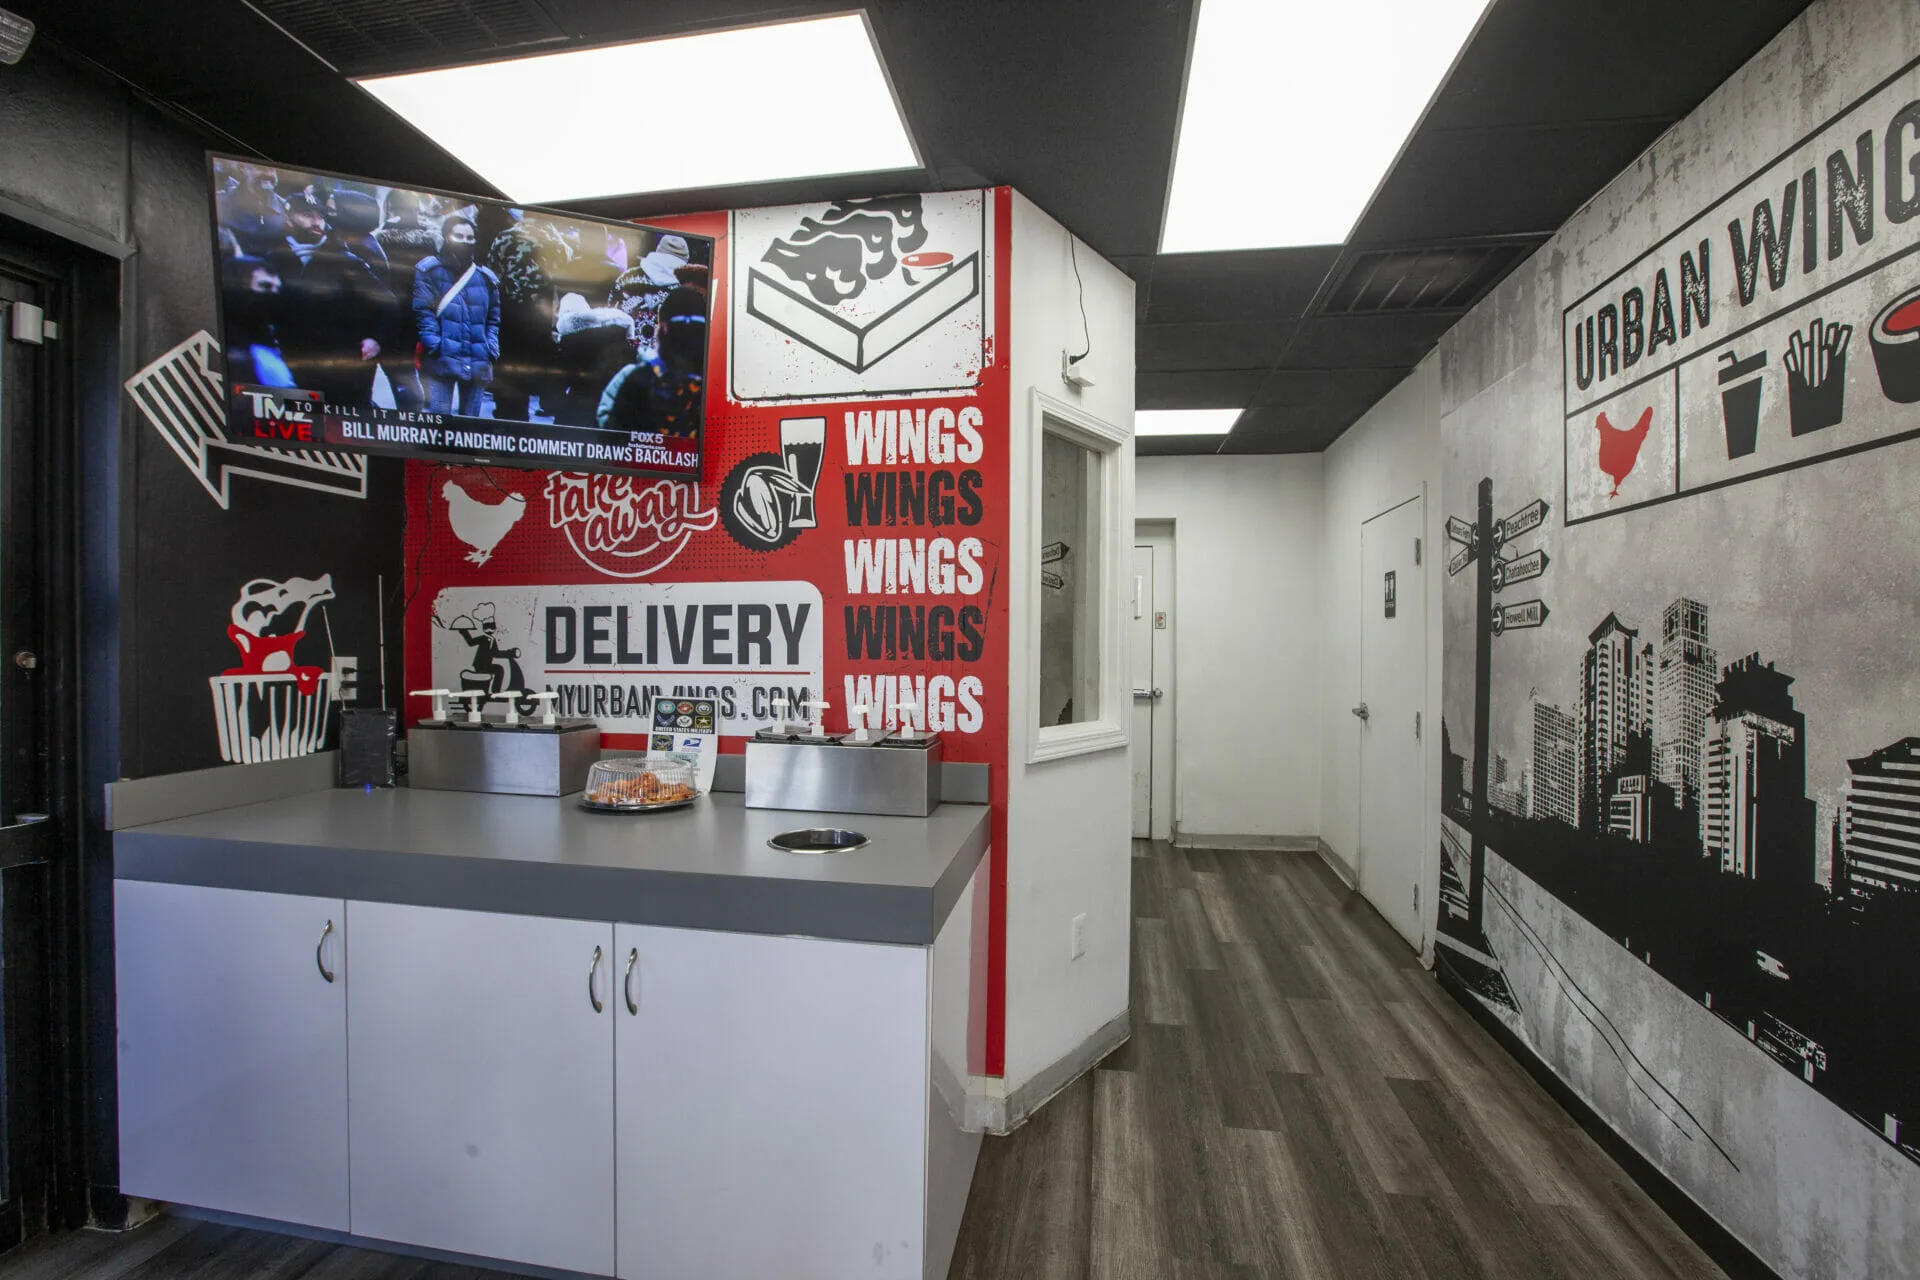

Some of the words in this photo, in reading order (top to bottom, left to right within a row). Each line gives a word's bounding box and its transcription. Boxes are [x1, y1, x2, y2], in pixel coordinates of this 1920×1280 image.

[1575, 237, 1710, 391] URBAN
[294, 400, 313, 412] TO
[323, 403, 360, 417] KILL
[372, 406, 387, 418] IT
[399, 411, 443, 425] MEANS
[630, 431, 654, 444] FOX
[654, 433, 665, 445] 5
[844, 406, 983, 465] WINGS
[342, 420, 375, 440] BILL
[377, 423, 442, 446] MURRAY:
[445, 431, 516, 451] PANDEMIC
[518, 437, 585, 457] COMMENT
[586, 443, 633, 462] DRAWS
[635, 448, 699, 468] BACKLASH
[543, 471, 633, 529] take
[585, 479, 718, 551] away
[844, 469, 983, 526] WINGS
[1506, 509, 1539, 536] Peachtree
[844, 537, 983, 595] WINGS
[545, 603, 811, 665] DELIVERY
[844, 605, 983, 662] WINGS
[1505, 611, 1526, 625] Howell
[1526, 605, 1539, 621] Mill
[545, 683, 814, 719] MYURBANS.COM
[844, 675, 983, 733] WINGS
